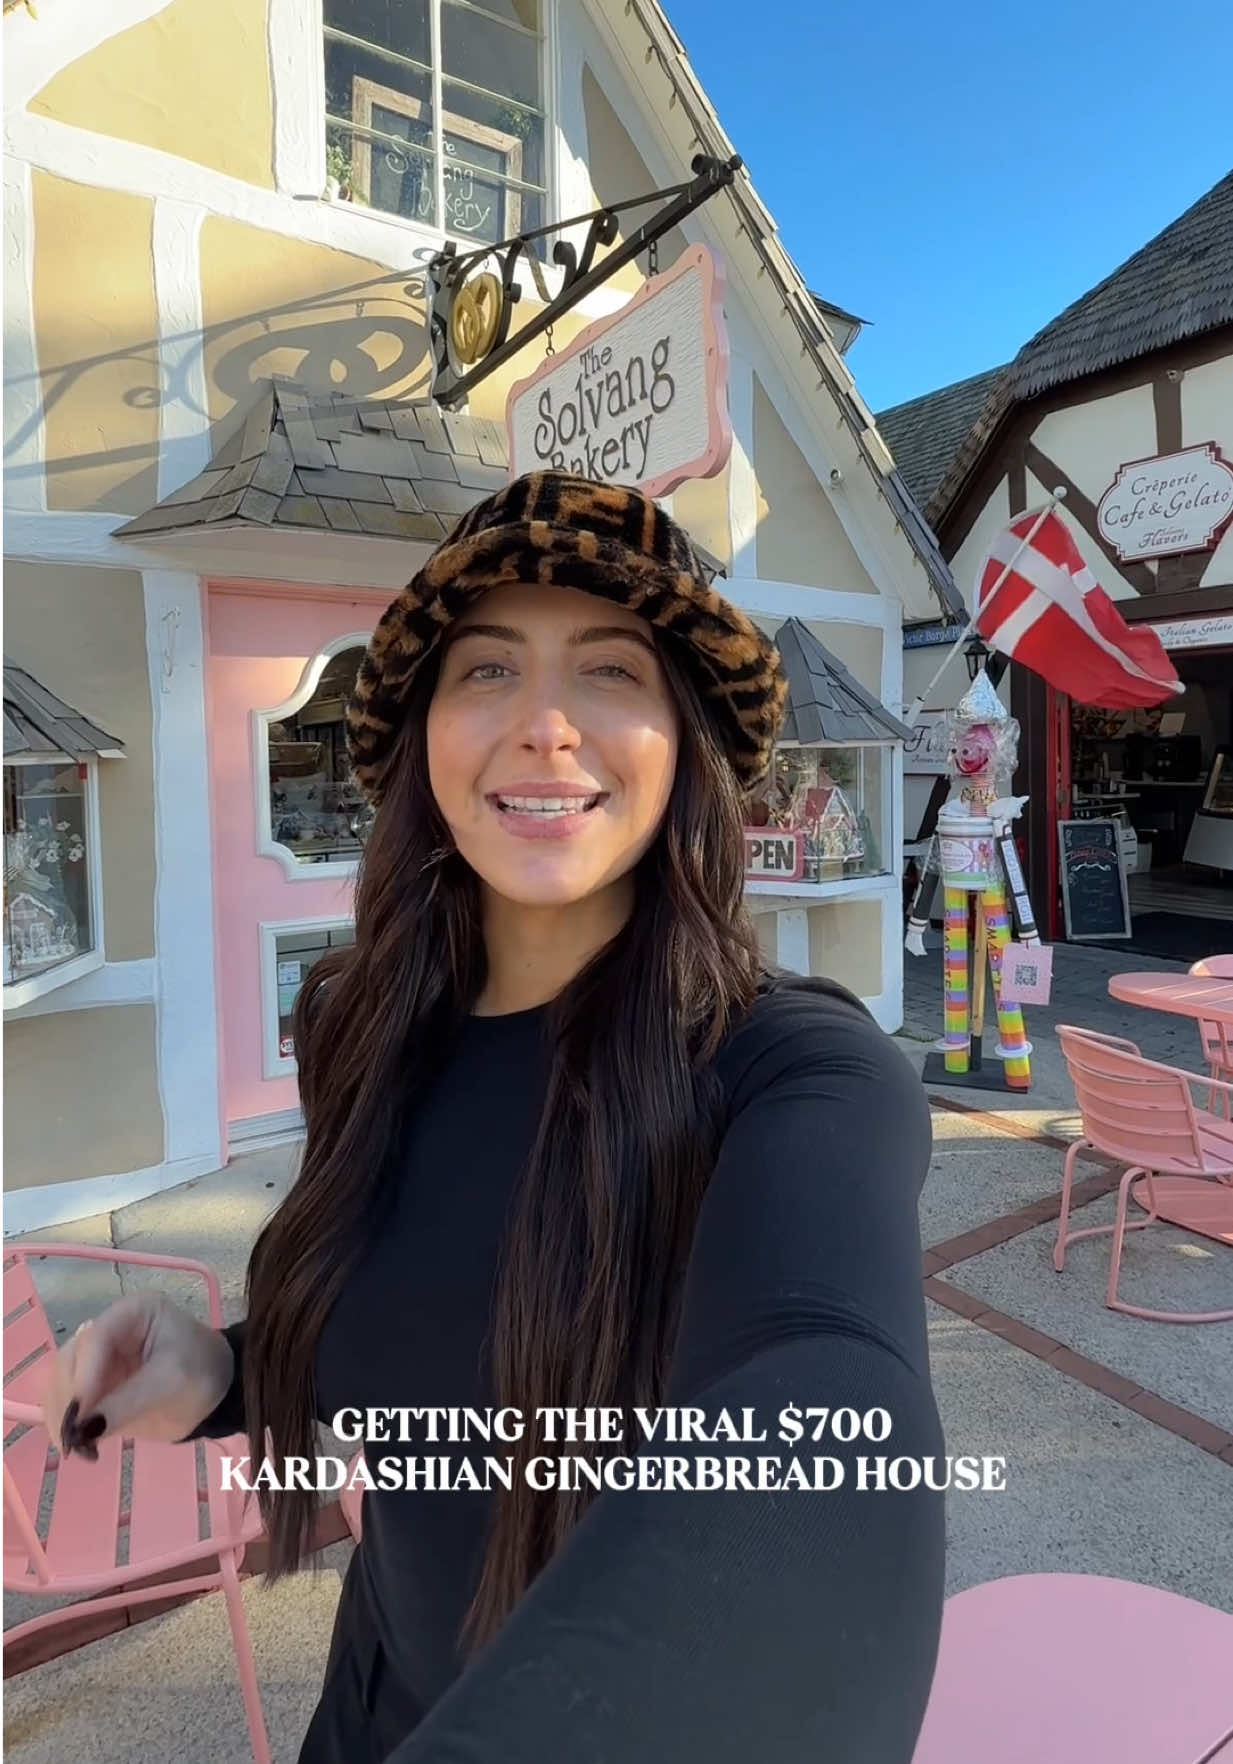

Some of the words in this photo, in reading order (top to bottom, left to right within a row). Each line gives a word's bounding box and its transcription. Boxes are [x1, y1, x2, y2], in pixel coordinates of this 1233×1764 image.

[579, 346, 612, 379] The
[534, 335, 676, 460] Solvang
[1149, 502, 1162, 516] &
[746, 839, 794, 870] PEN
